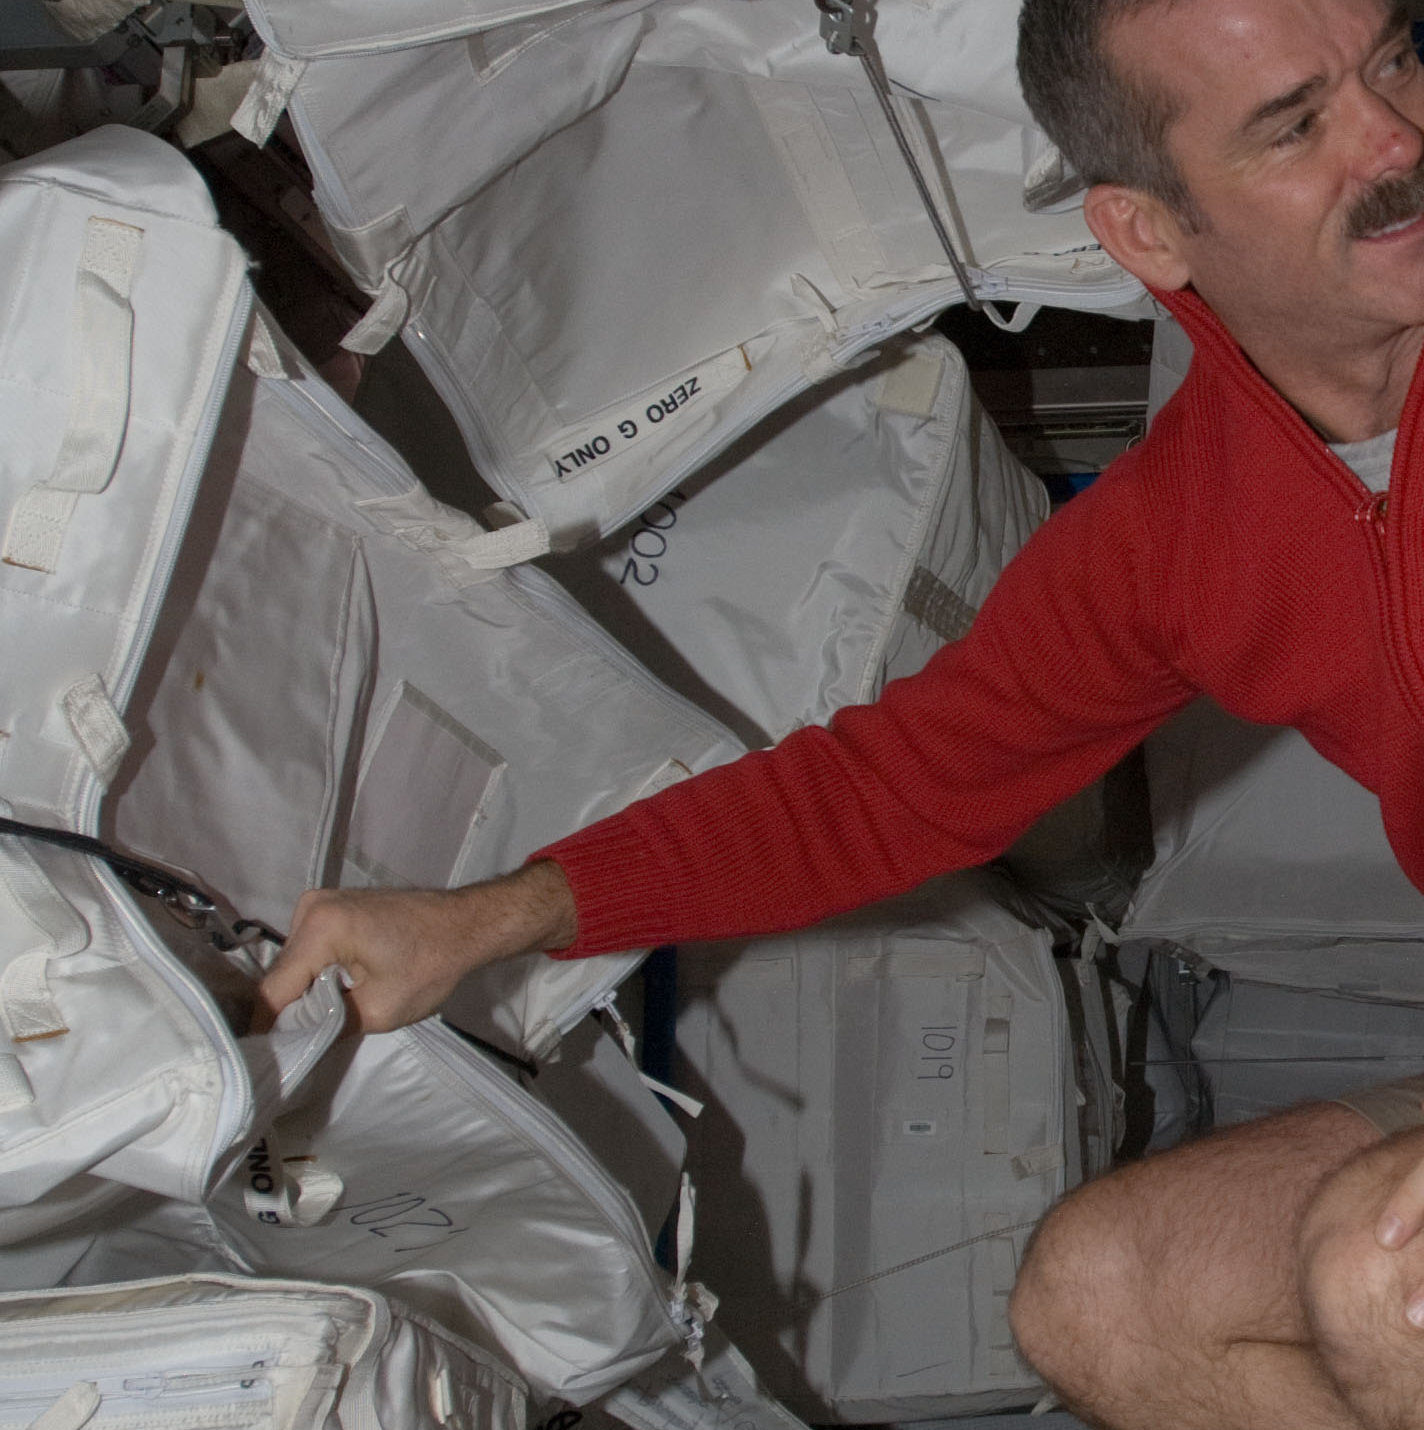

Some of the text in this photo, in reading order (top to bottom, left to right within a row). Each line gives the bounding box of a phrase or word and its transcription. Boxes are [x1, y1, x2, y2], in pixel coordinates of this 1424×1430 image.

[553, 377, 703, 479] ZERO G ONLY
[919, 1024, 957, 1082] 1019
[247, 1137, 281, 1226] G ONL
